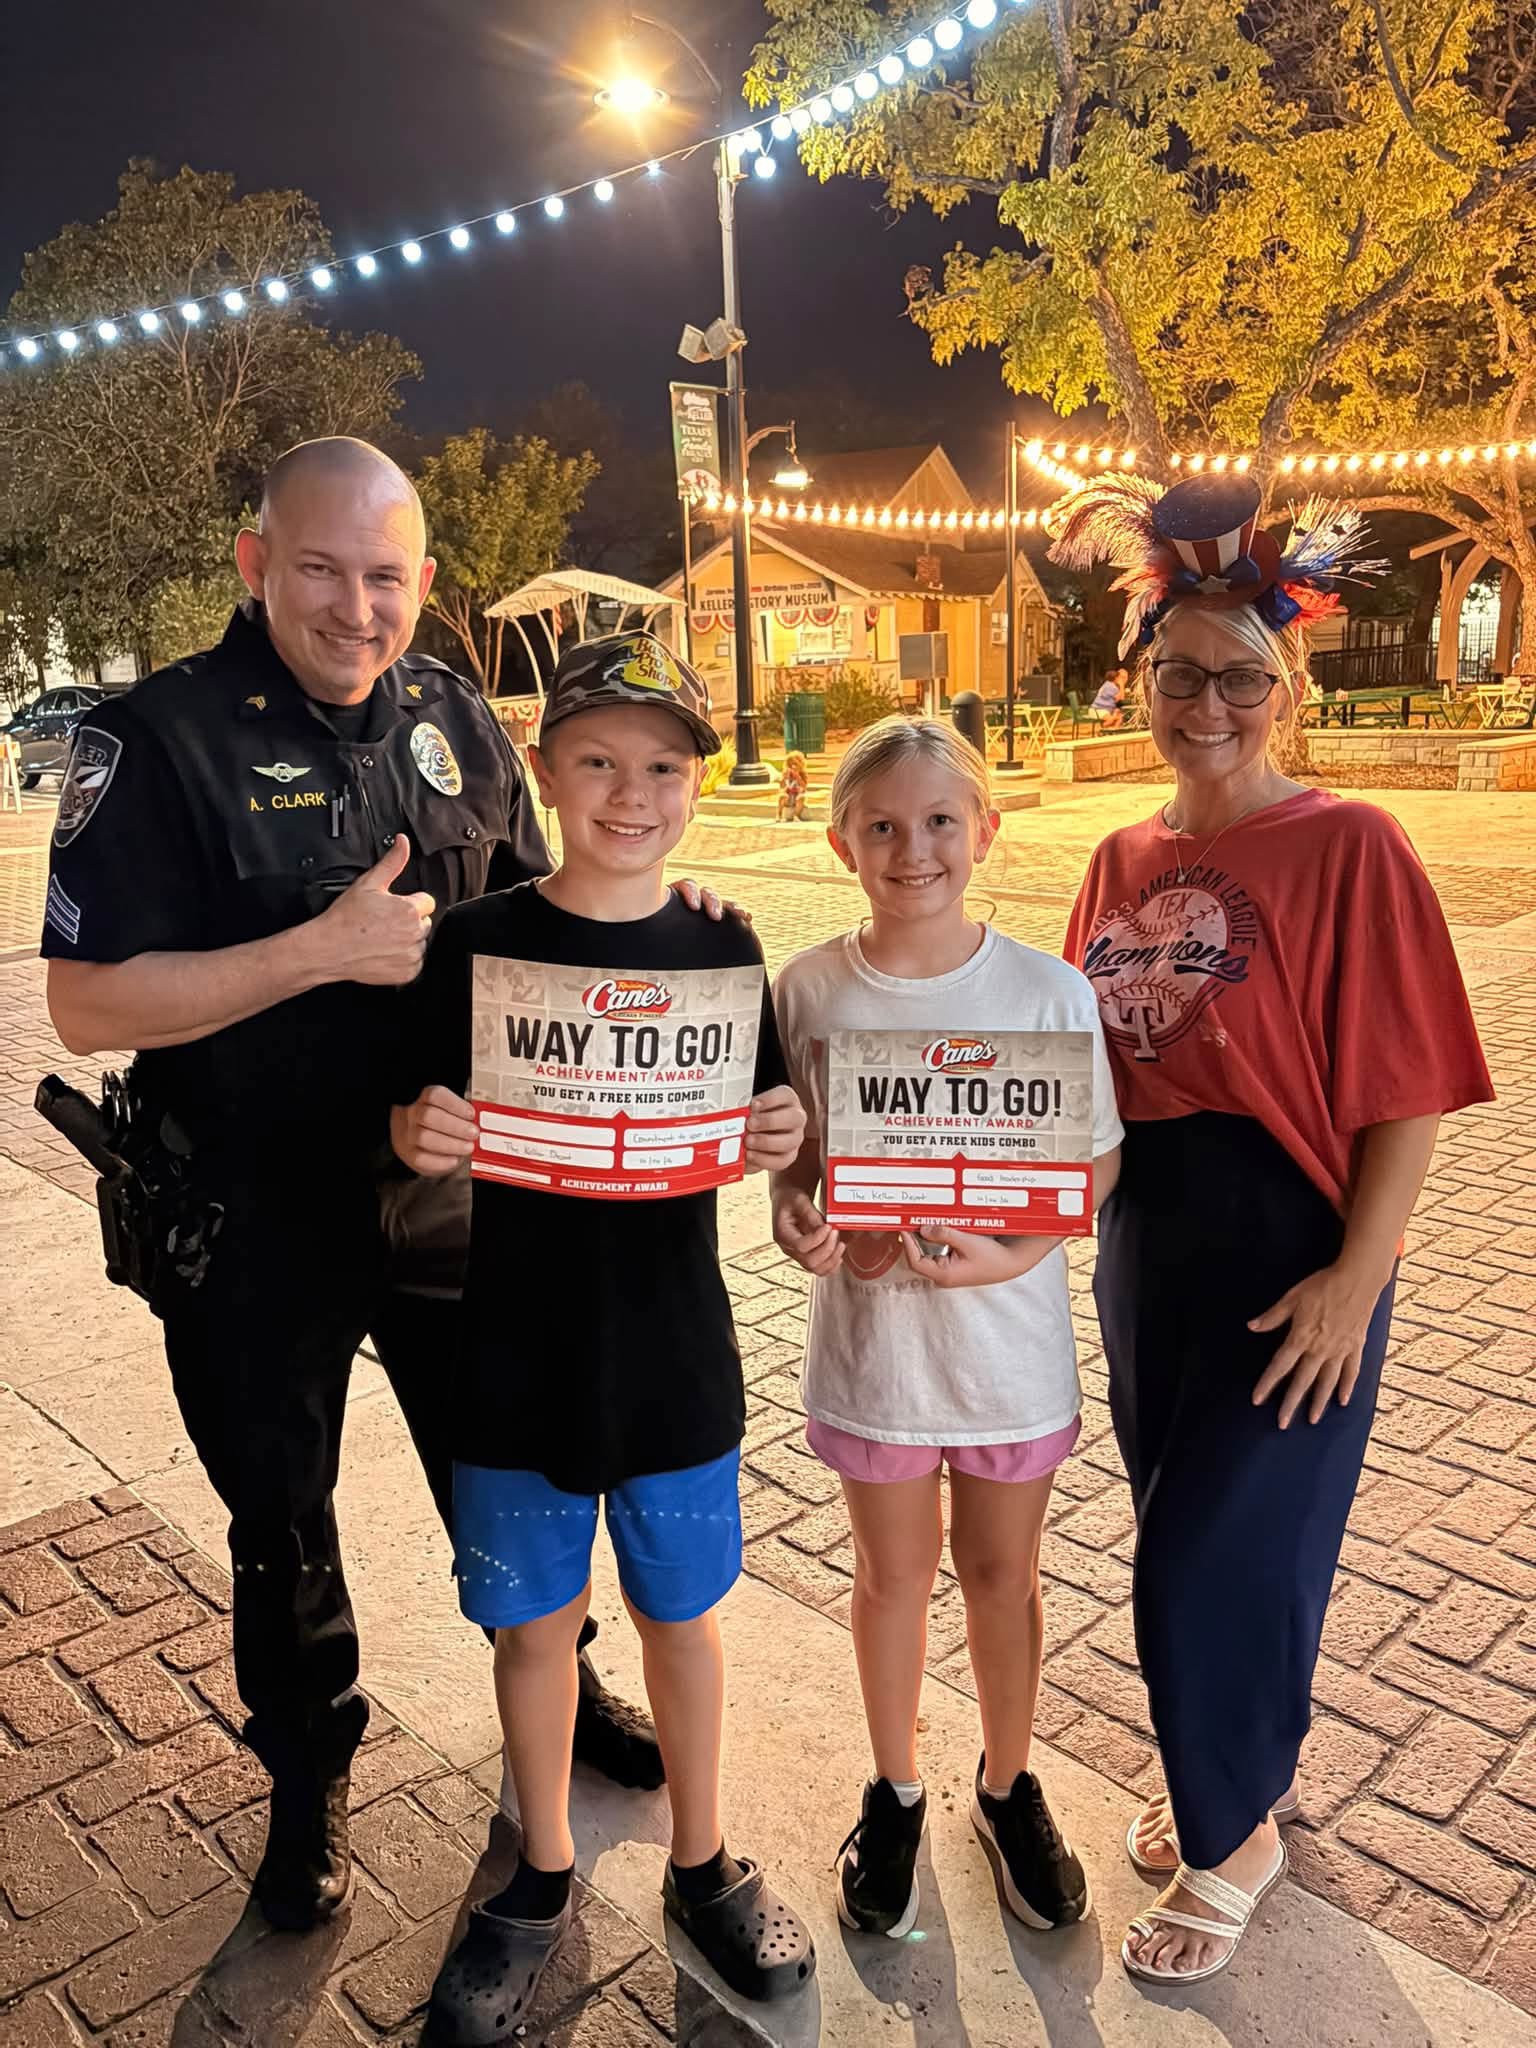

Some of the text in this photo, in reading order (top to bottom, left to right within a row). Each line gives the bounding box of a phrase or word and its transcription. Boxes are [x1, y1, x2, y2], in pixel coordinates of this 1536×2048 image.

[700, 593, 829, 611] KELLER STORY MUSEUM
[636, 637, 670, 662] Bass
[637, 652, 664, 669] Pro
[635, 664, 678, 689] Shops
[78, 744, 108, 768] LER
[250, 792, 327, 812] A. CLARK
[1139, 864, 1230, 905] AMERICAN
[1219, 881, 1257, 951] LEAGUE
[1157, 891, 1194, 920] TEX
[585, 979, 672, 1017] Cane's
[506, 1015, 733, 1069] WAY TO GO!
[925, 1038, 997, 1072] Cane's
[536, 1064, 705, 1083] ACHIEVEMENT AWARD
[533, 1084, 705, 1104] YOU GET A FREE KIDS COMBO
[858, 1076, 1061, 1117] WAY TO GO!
[884, 1116, 1034, 1129] ACHIEVEMENT AWARD
[883, 1135, 1036, 1148] YOU GET A FREE KIDS COMBO
[560, 1178, 669, 1193] ACHIEVEMENT AWARD
[909, 1216, 1006, 1228] ACHIEVEMENT AWARD
